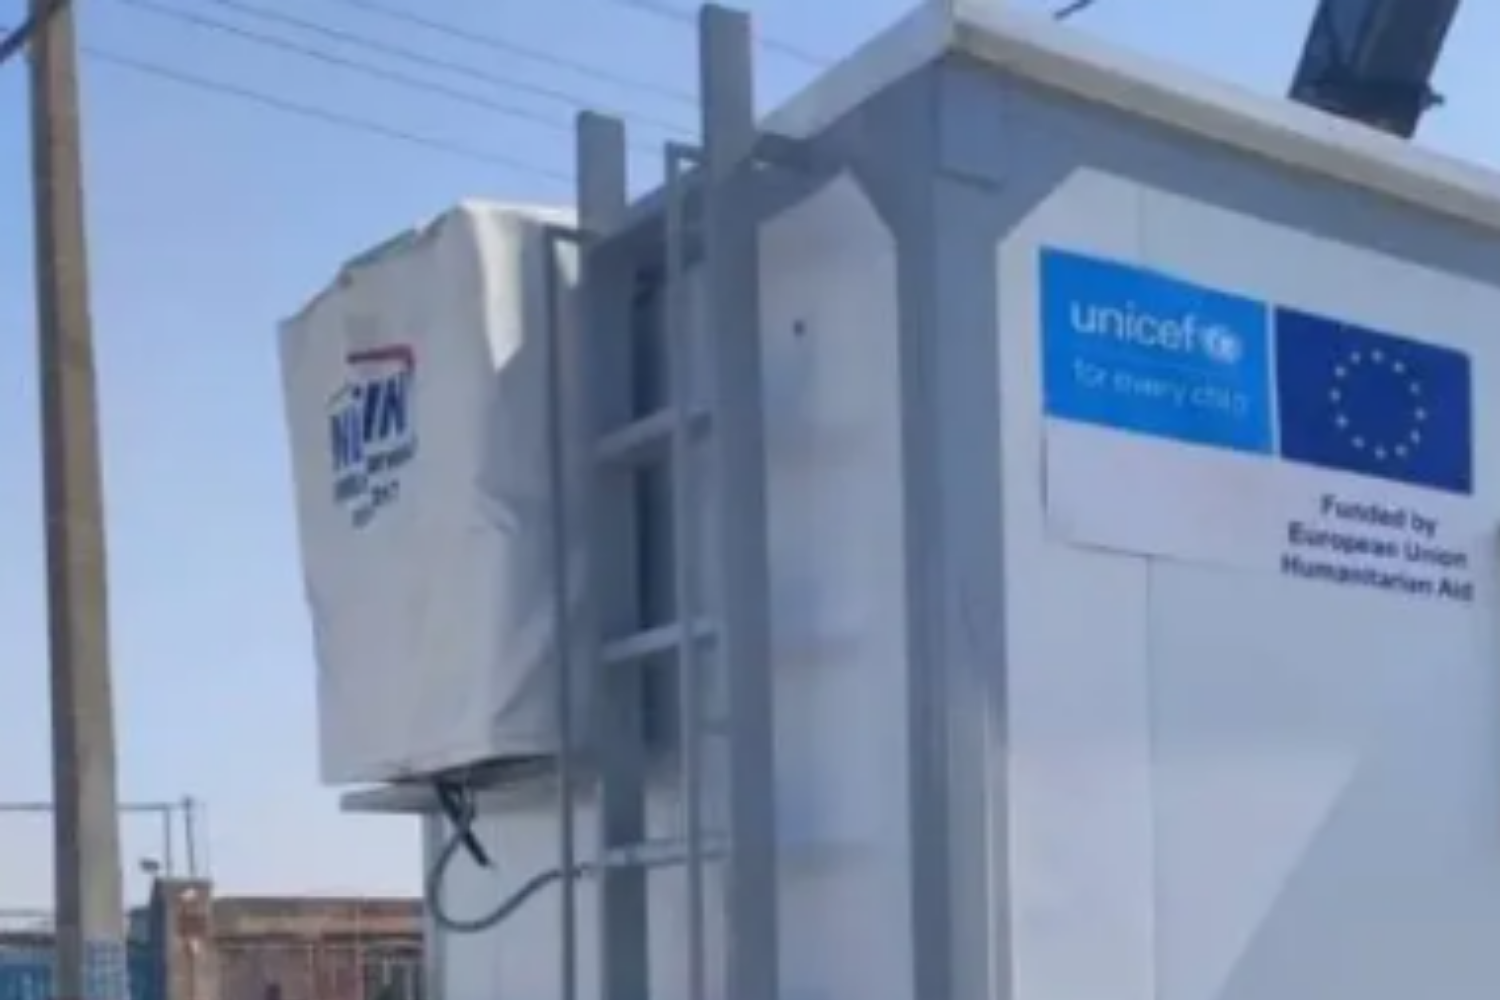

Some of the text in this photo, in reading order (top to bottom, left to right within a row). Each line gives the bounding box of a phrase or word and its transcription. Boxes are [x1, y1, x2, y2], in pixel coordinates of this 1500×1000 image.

[1069, 301, 1195, 351] unicef
[1321, 494, 1438, 538] Funded by
[1288, 521, 1468, 568] European Union
[1280, 554, 1475, 604] Humanitarian Aid
